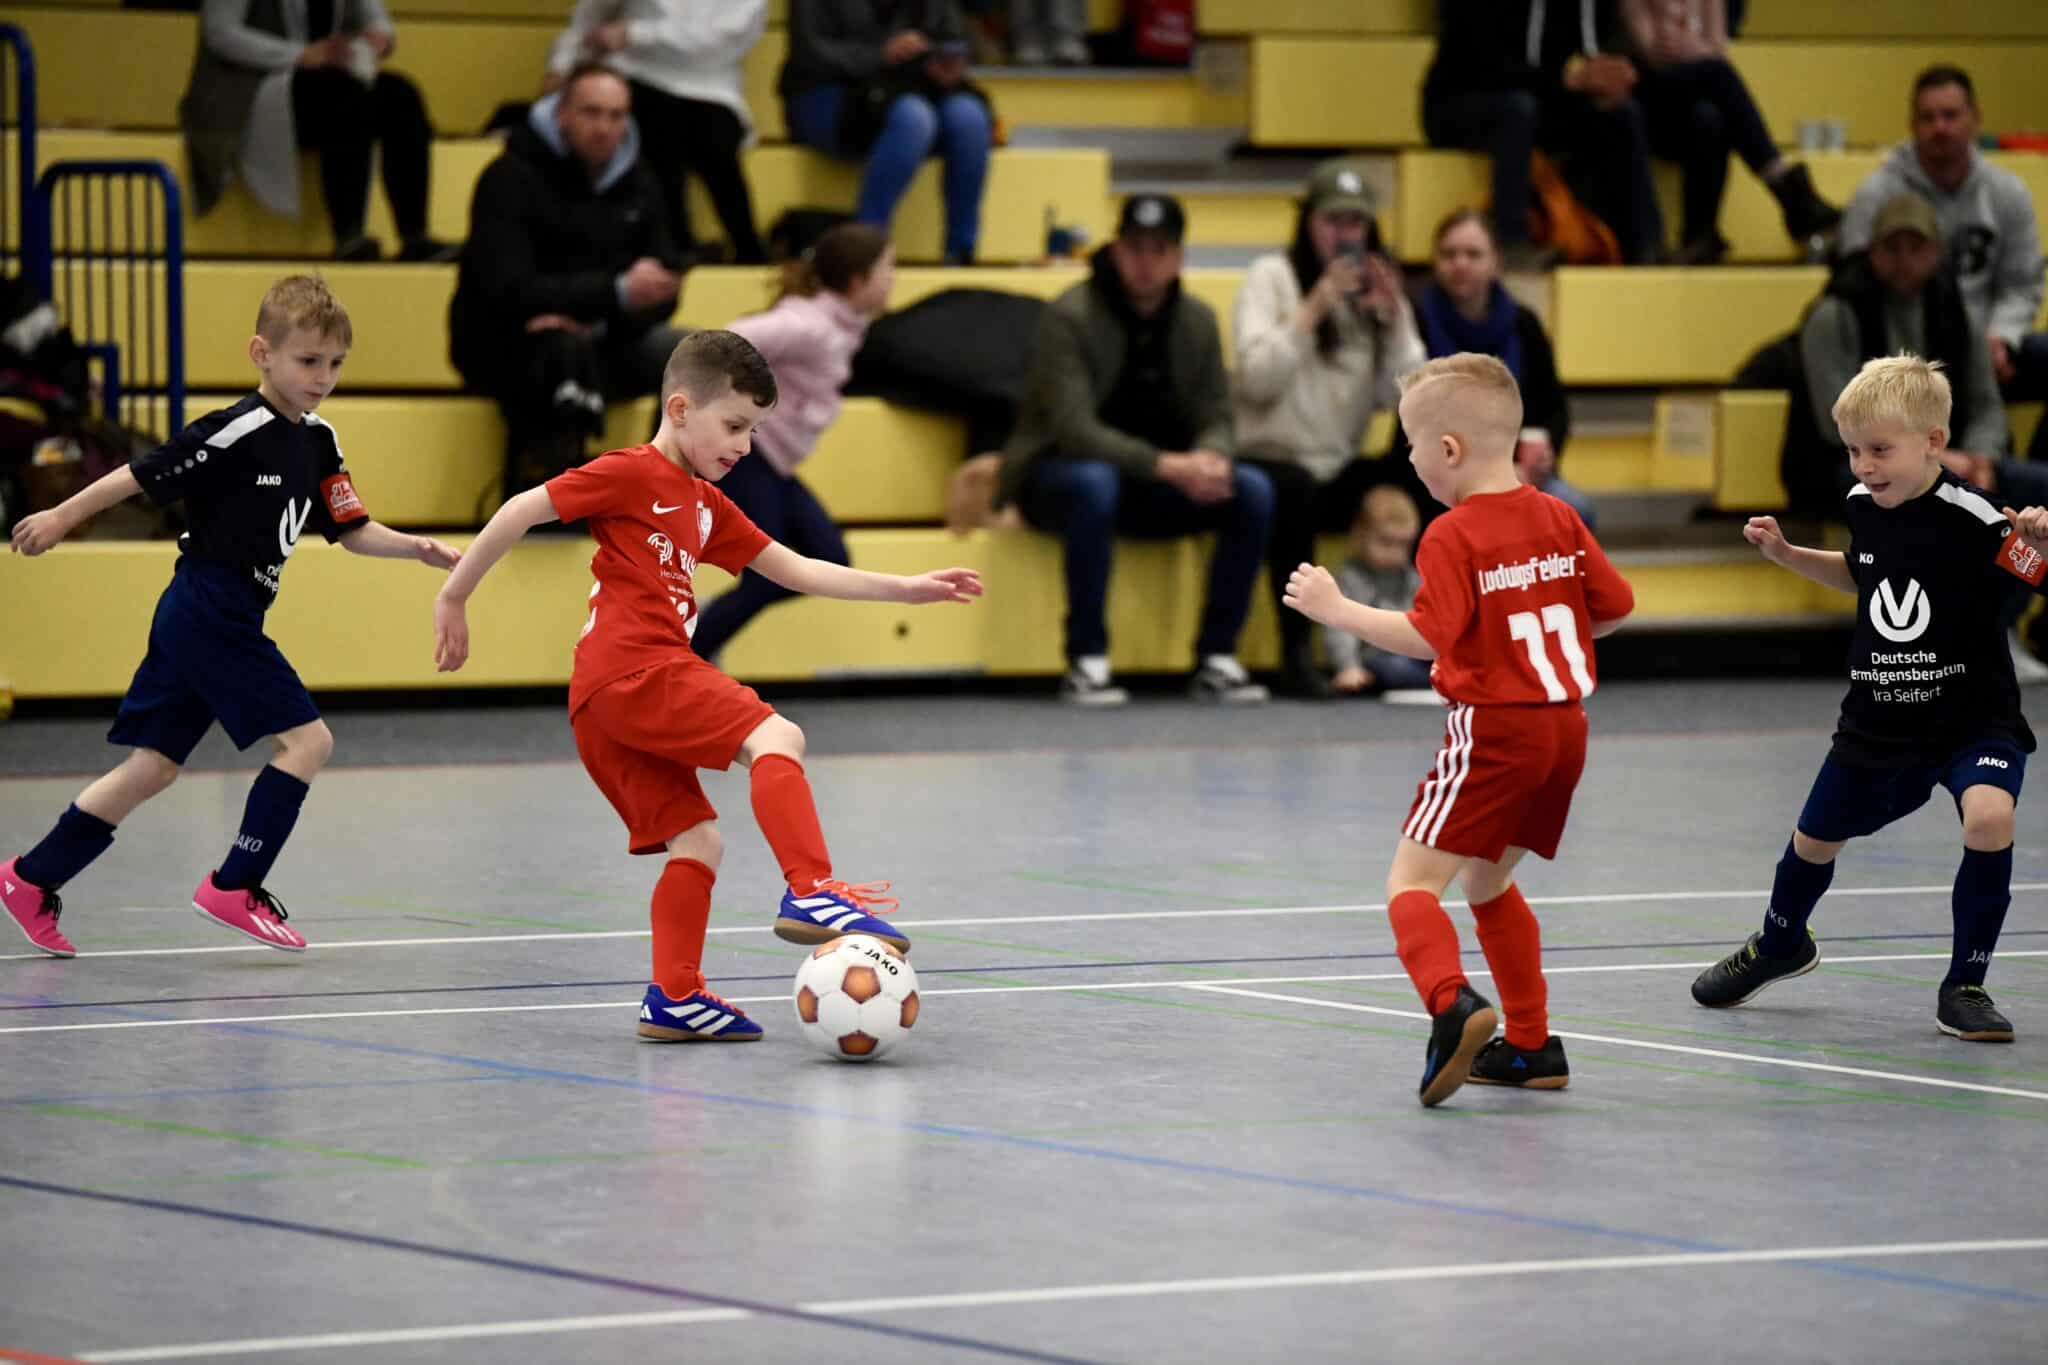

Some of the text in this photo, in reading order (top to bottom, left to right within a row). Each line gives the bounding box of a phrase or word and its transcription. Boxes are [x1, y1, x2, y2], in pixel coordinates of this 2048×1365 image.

[256, 475, 282, 486] JAKO
[1507, 603, 1595, 702] 11
[1871, 650, 1937, 665] Deutsche
[1894, 685, 1943, 703] Seifert
[1976, 755, 2009, 769] JAKO
[863, 948, 898, 976] JAKO
